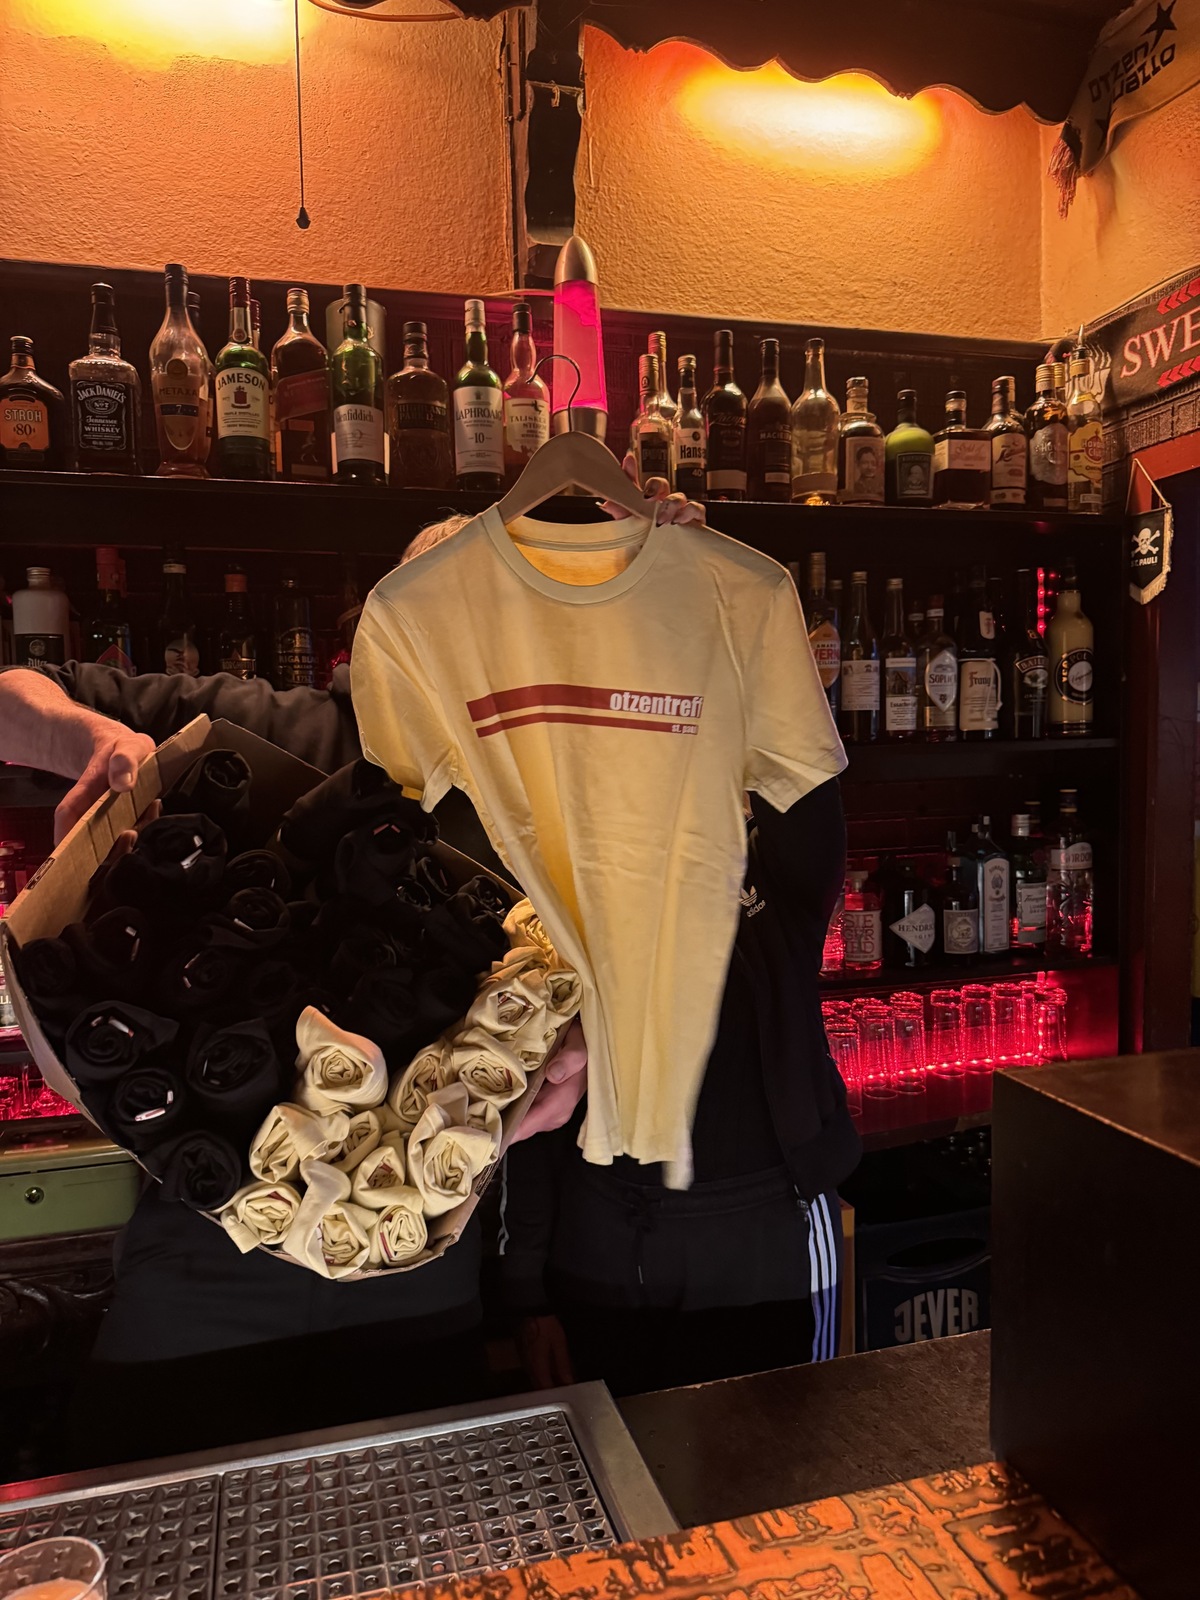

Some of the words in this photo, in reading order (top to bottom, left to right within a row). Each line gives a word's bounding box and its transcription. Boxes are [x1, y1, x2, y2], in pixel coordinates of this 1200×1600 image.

[217, 372, 266, 391] JAMESON
[77, 387, 96, 401] JACK
[96, 385, 127, 404] DANIEL'S
[158, 387, 199, 396] METAXA
[5, 409, 42, 422] STROH
[176, 404, 182, 414] 7
[16, 424, 32, 435] 80
[474, 432, 485, 443] 10
[746, 899, 766, 917] adidas
[894, 1287, 979, 1343] JEVER
